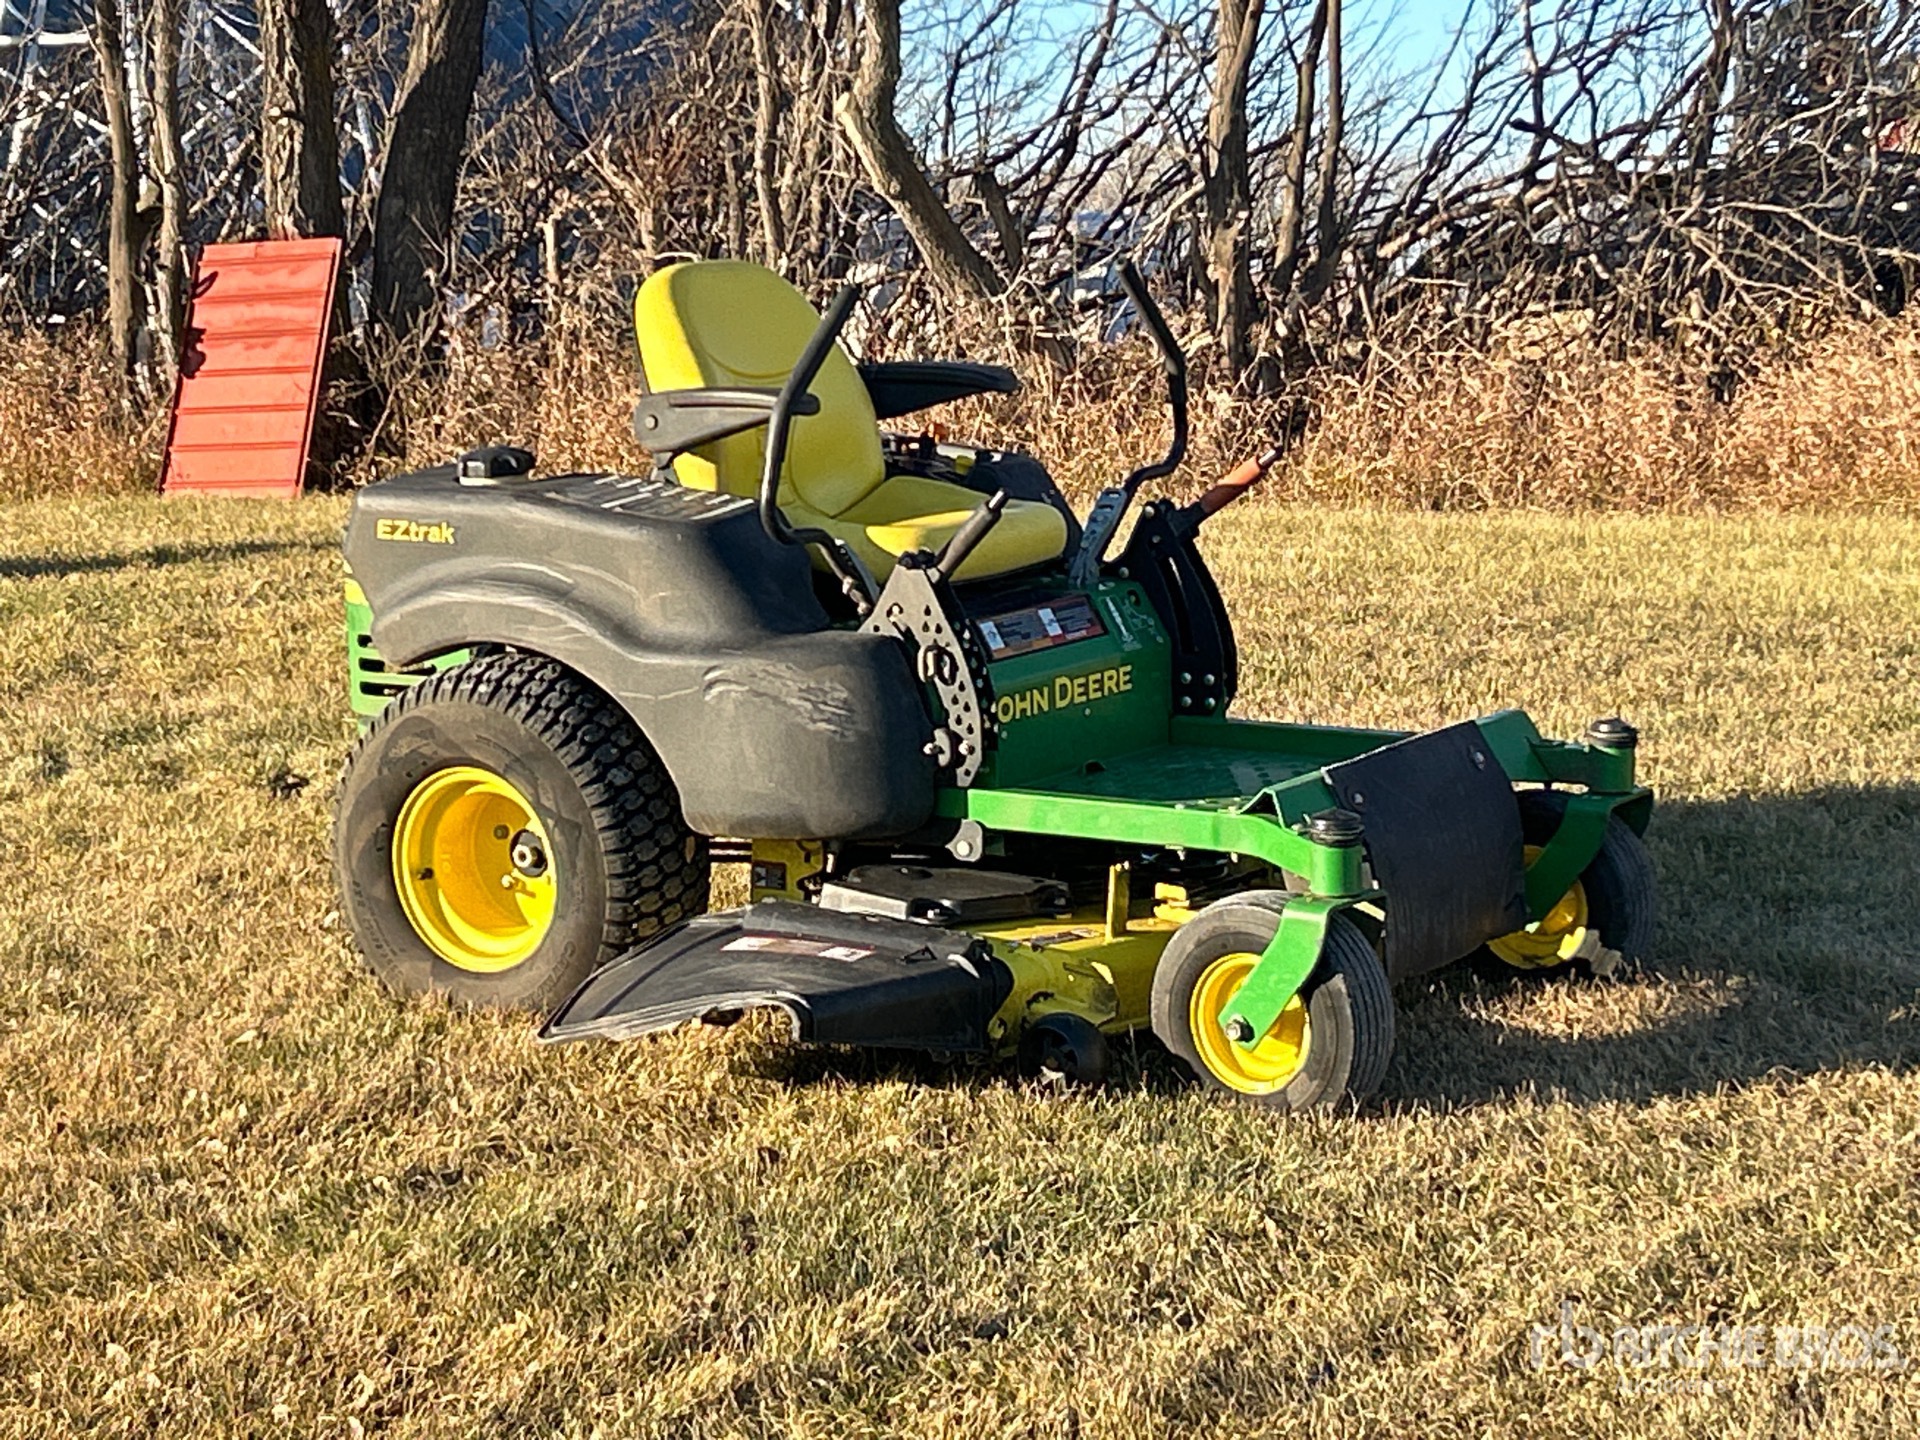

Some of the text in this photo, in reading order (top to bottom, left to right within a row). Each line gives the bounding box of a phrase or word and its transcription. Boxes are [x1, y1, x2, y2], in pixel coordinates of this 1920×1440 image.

[376, 519, 455, 544] EZtrak
[997, 665, 1133, 723] OHN DEERE
